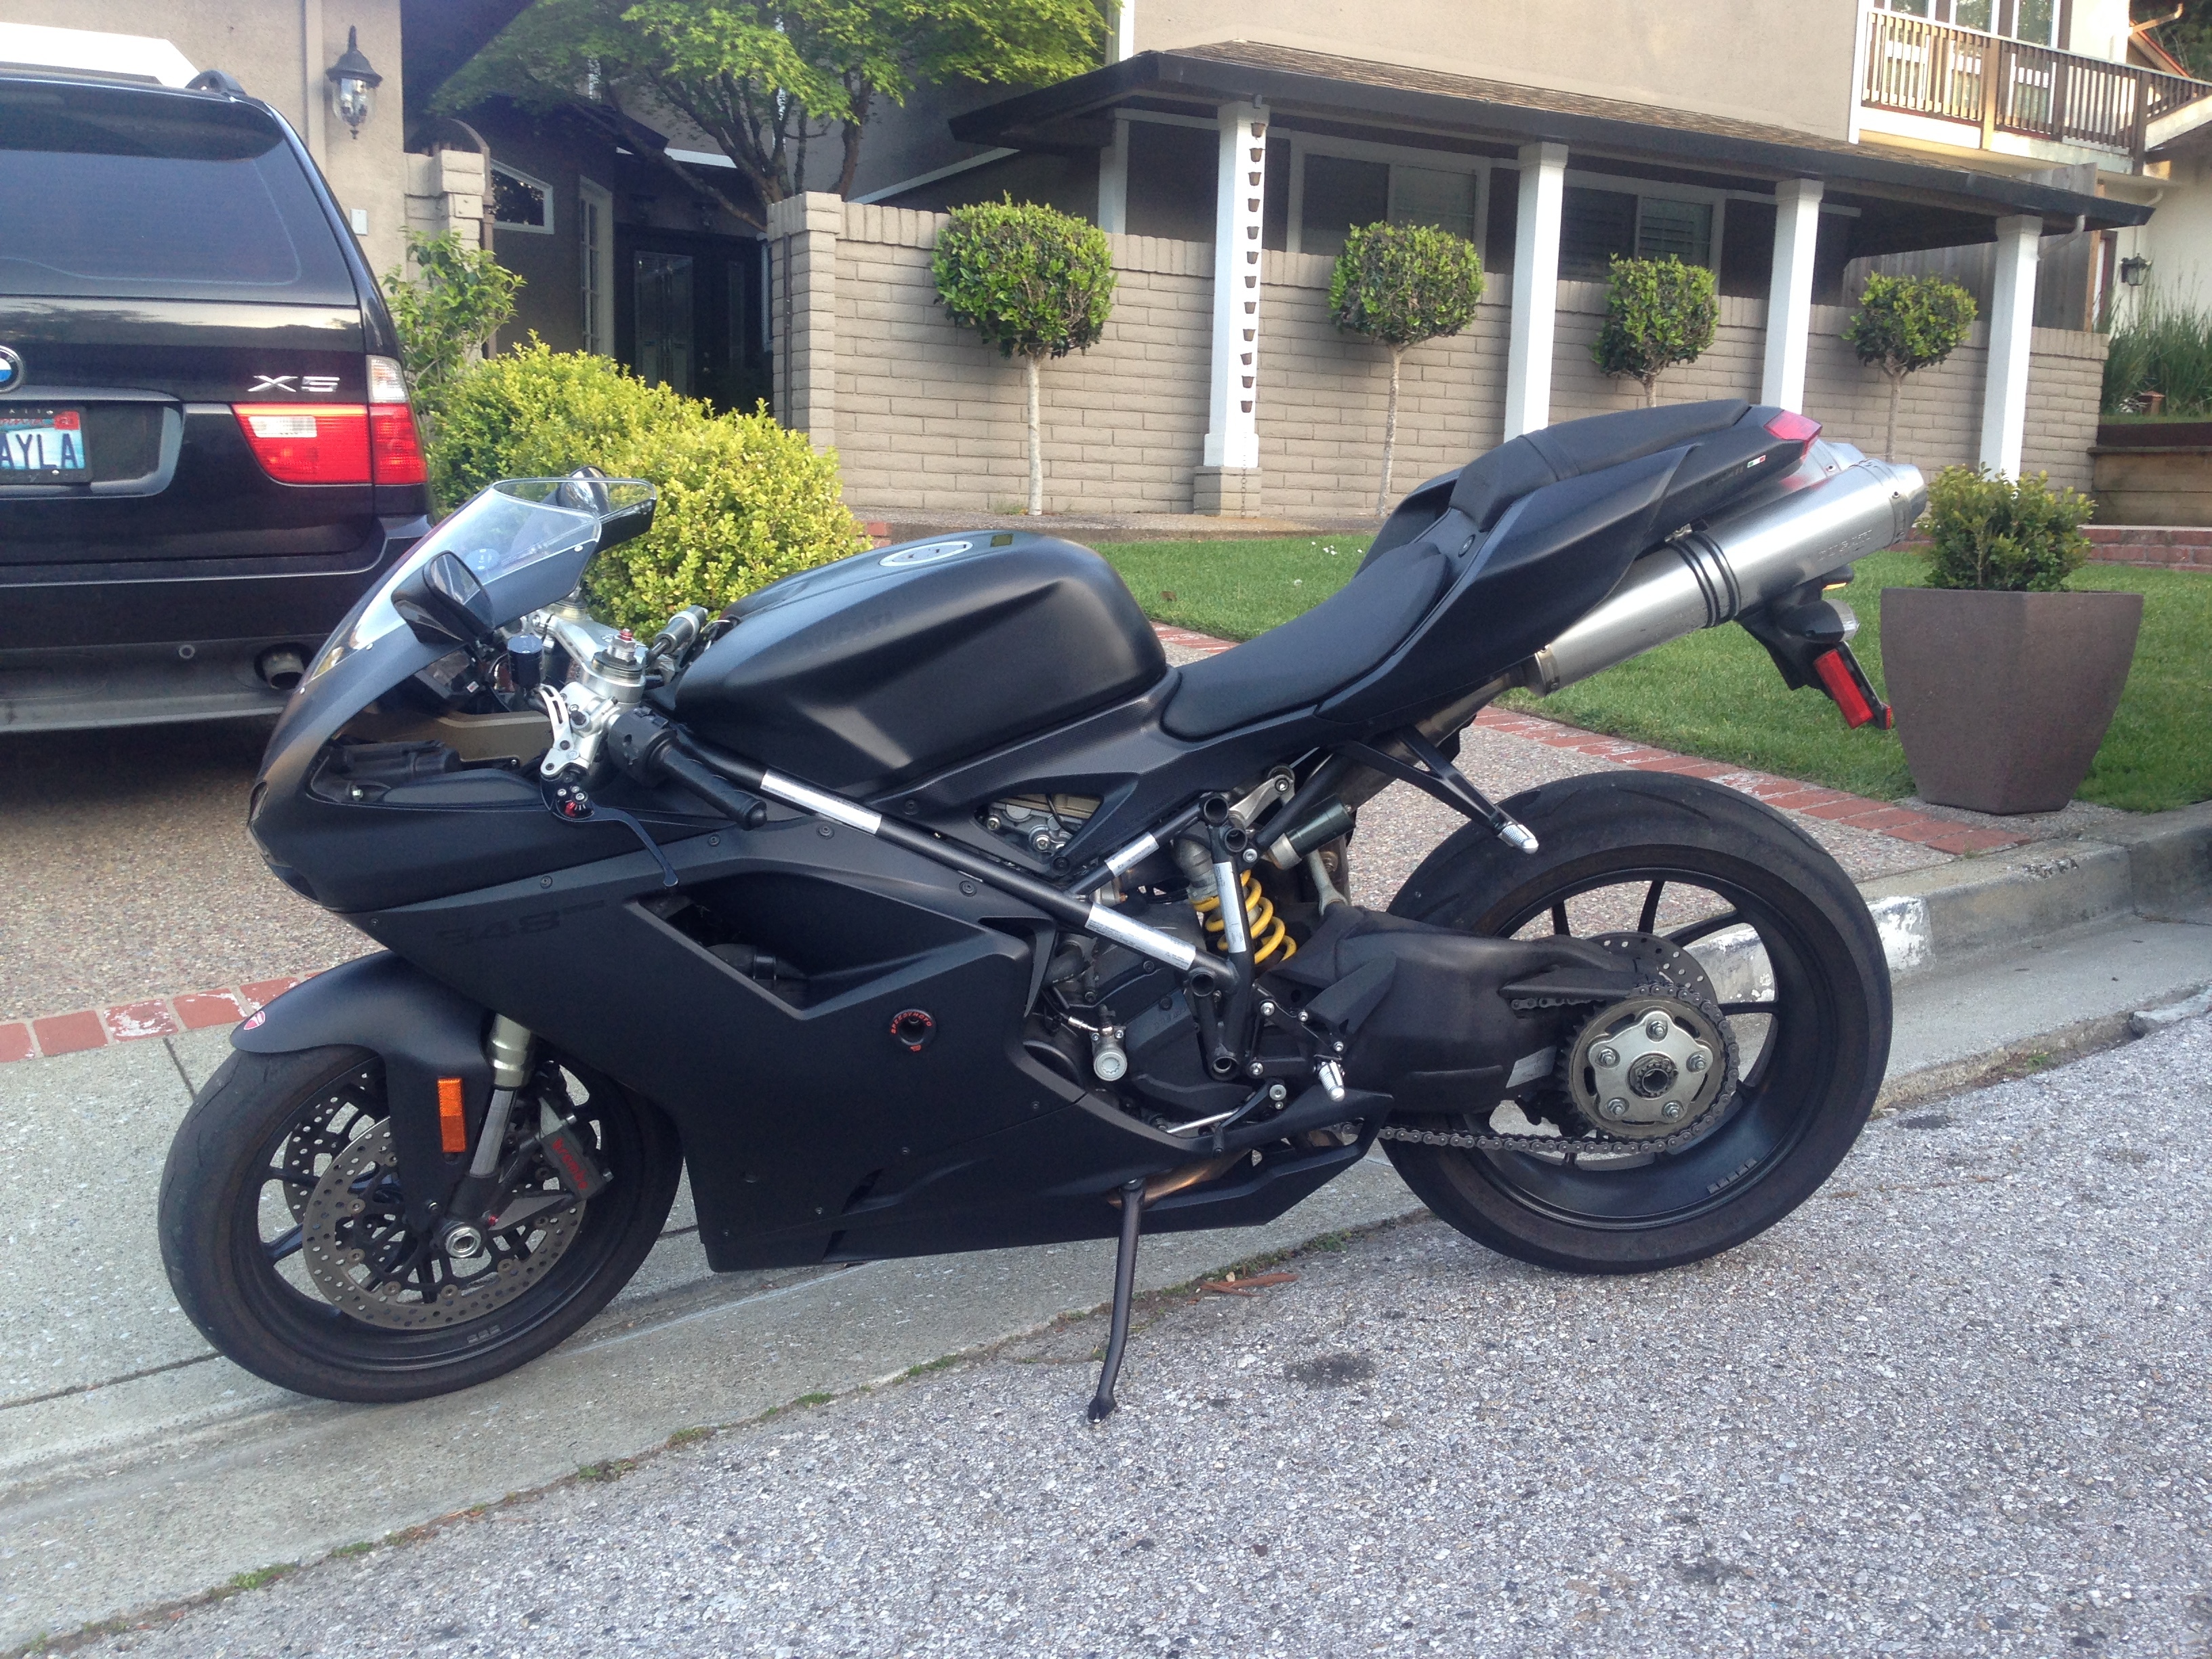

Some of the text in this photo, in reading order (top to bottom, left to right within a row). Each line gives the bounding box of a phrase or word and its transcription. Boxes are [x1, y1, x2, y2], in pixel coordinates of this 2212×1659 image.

[247, 375, 340, 392] X5
[890, 1011, 932, 1034] SPEEDYMOTO
[552, 1136, 588, 1189] brembo
